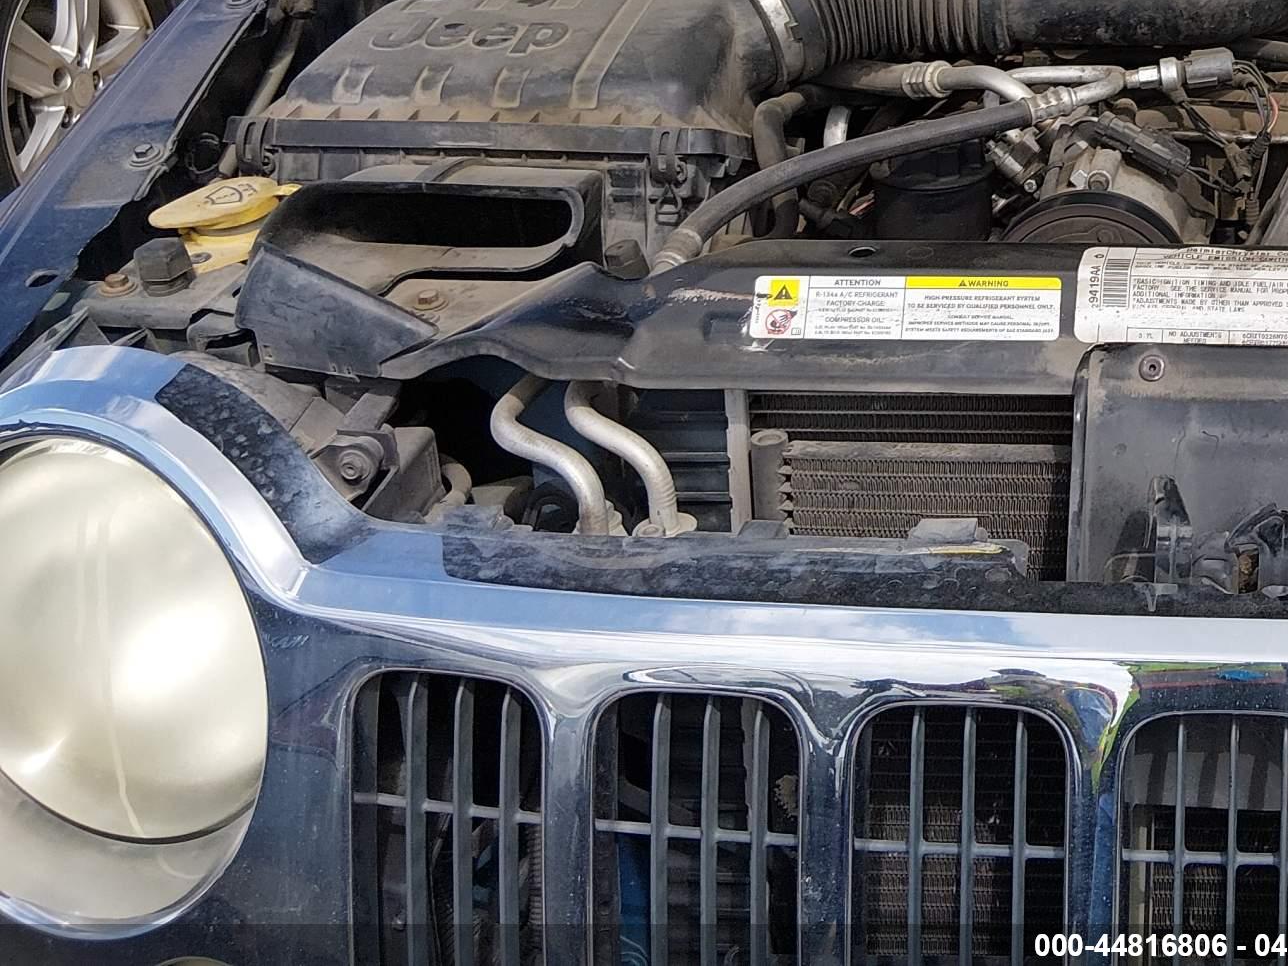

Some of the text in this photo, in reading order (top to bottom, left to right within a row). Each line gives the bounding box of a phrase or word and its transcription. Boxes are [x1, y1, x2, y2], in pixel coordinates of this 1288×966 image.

[370, 16, 571, 56] Jeep
[834, 279, 882, 287] ATTENTION
[854, 291, 898, 299] REFRIGERANT
